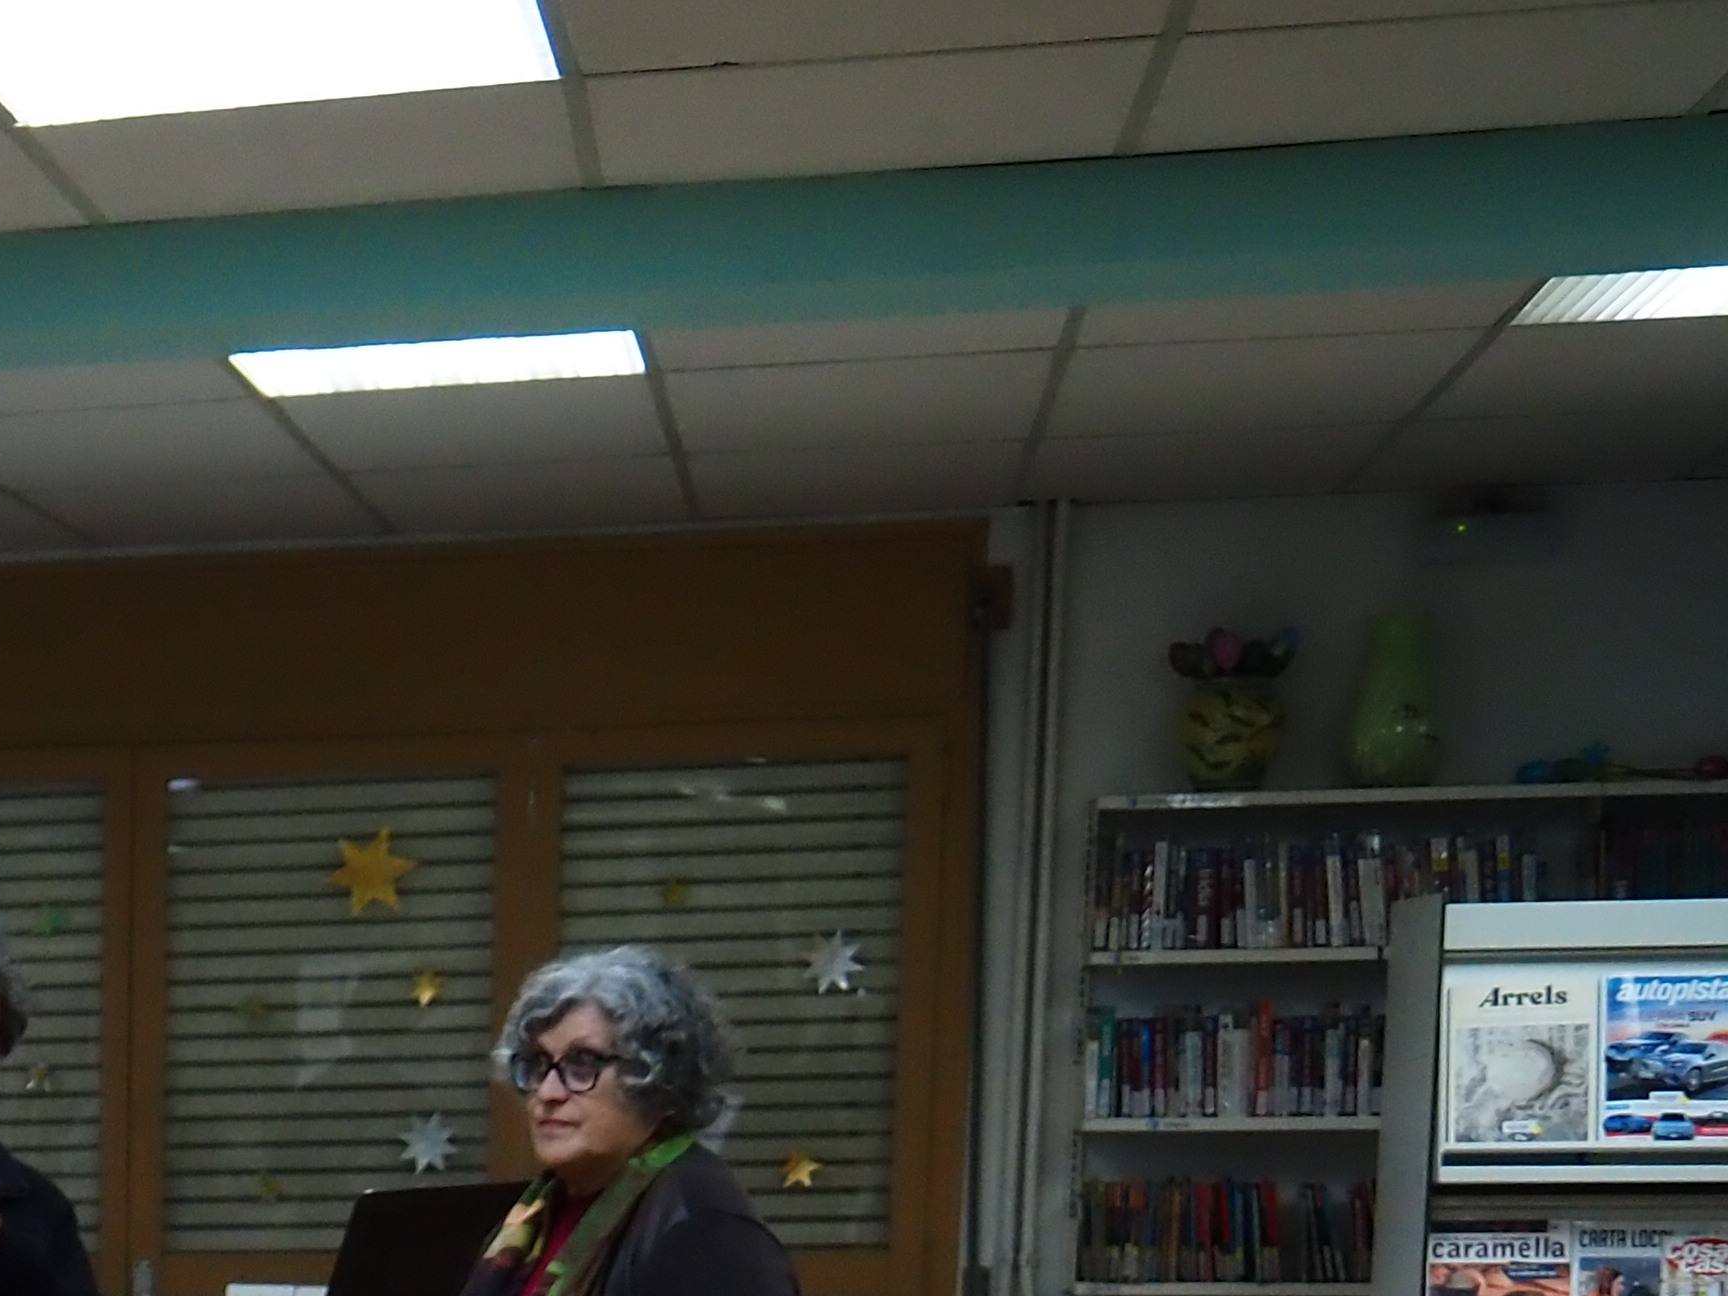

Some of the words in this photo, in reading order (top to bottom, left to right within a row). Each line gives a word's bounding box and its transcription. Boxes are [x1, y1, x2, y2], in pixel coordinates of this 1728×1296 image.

[1479, 985, 1568, 1008] Arrels
[1615, 978, 1728, 1006] autopista
[1432, 1236, 1565, 1258] caramella
